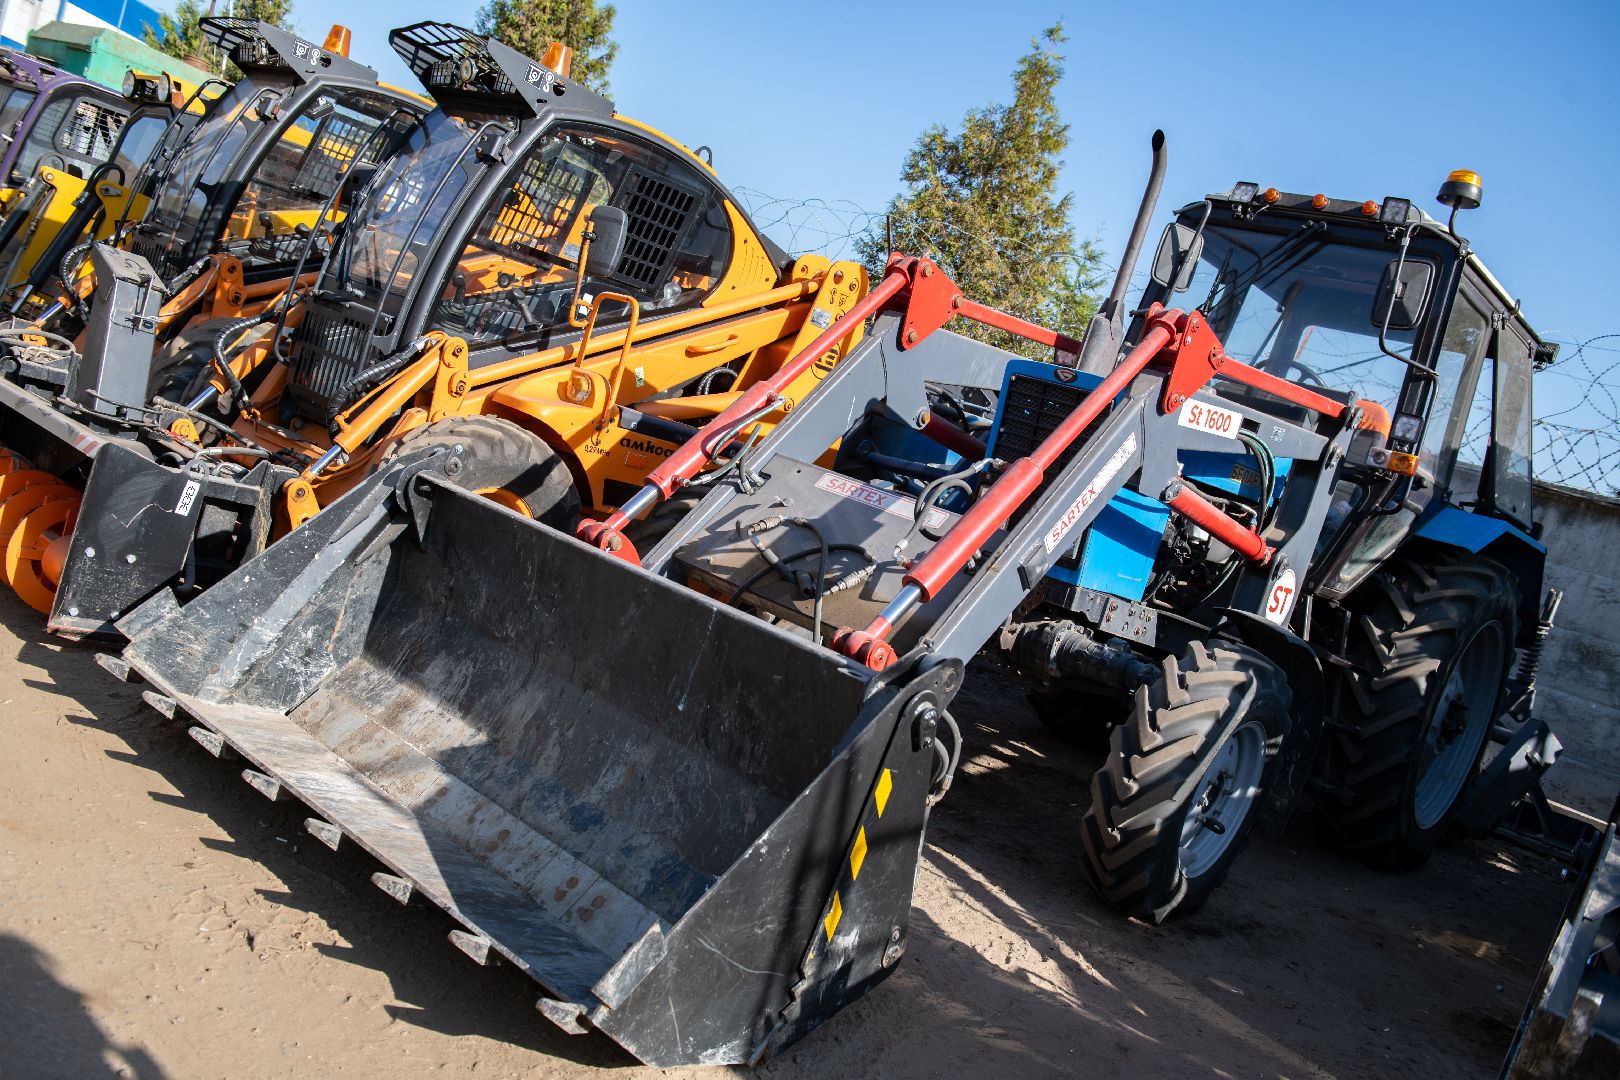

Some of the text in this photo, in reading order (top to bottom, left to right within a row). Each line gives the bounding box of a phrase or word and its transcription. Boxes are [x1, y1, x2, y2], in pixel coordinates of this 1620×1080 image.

[1188, 404, 1233, 433] St 1600
[825, 478, 888, 506] SARTEX
[1051, 483, 1097, 543] SARTEX
[1268, 585, 1293, 615] ST
